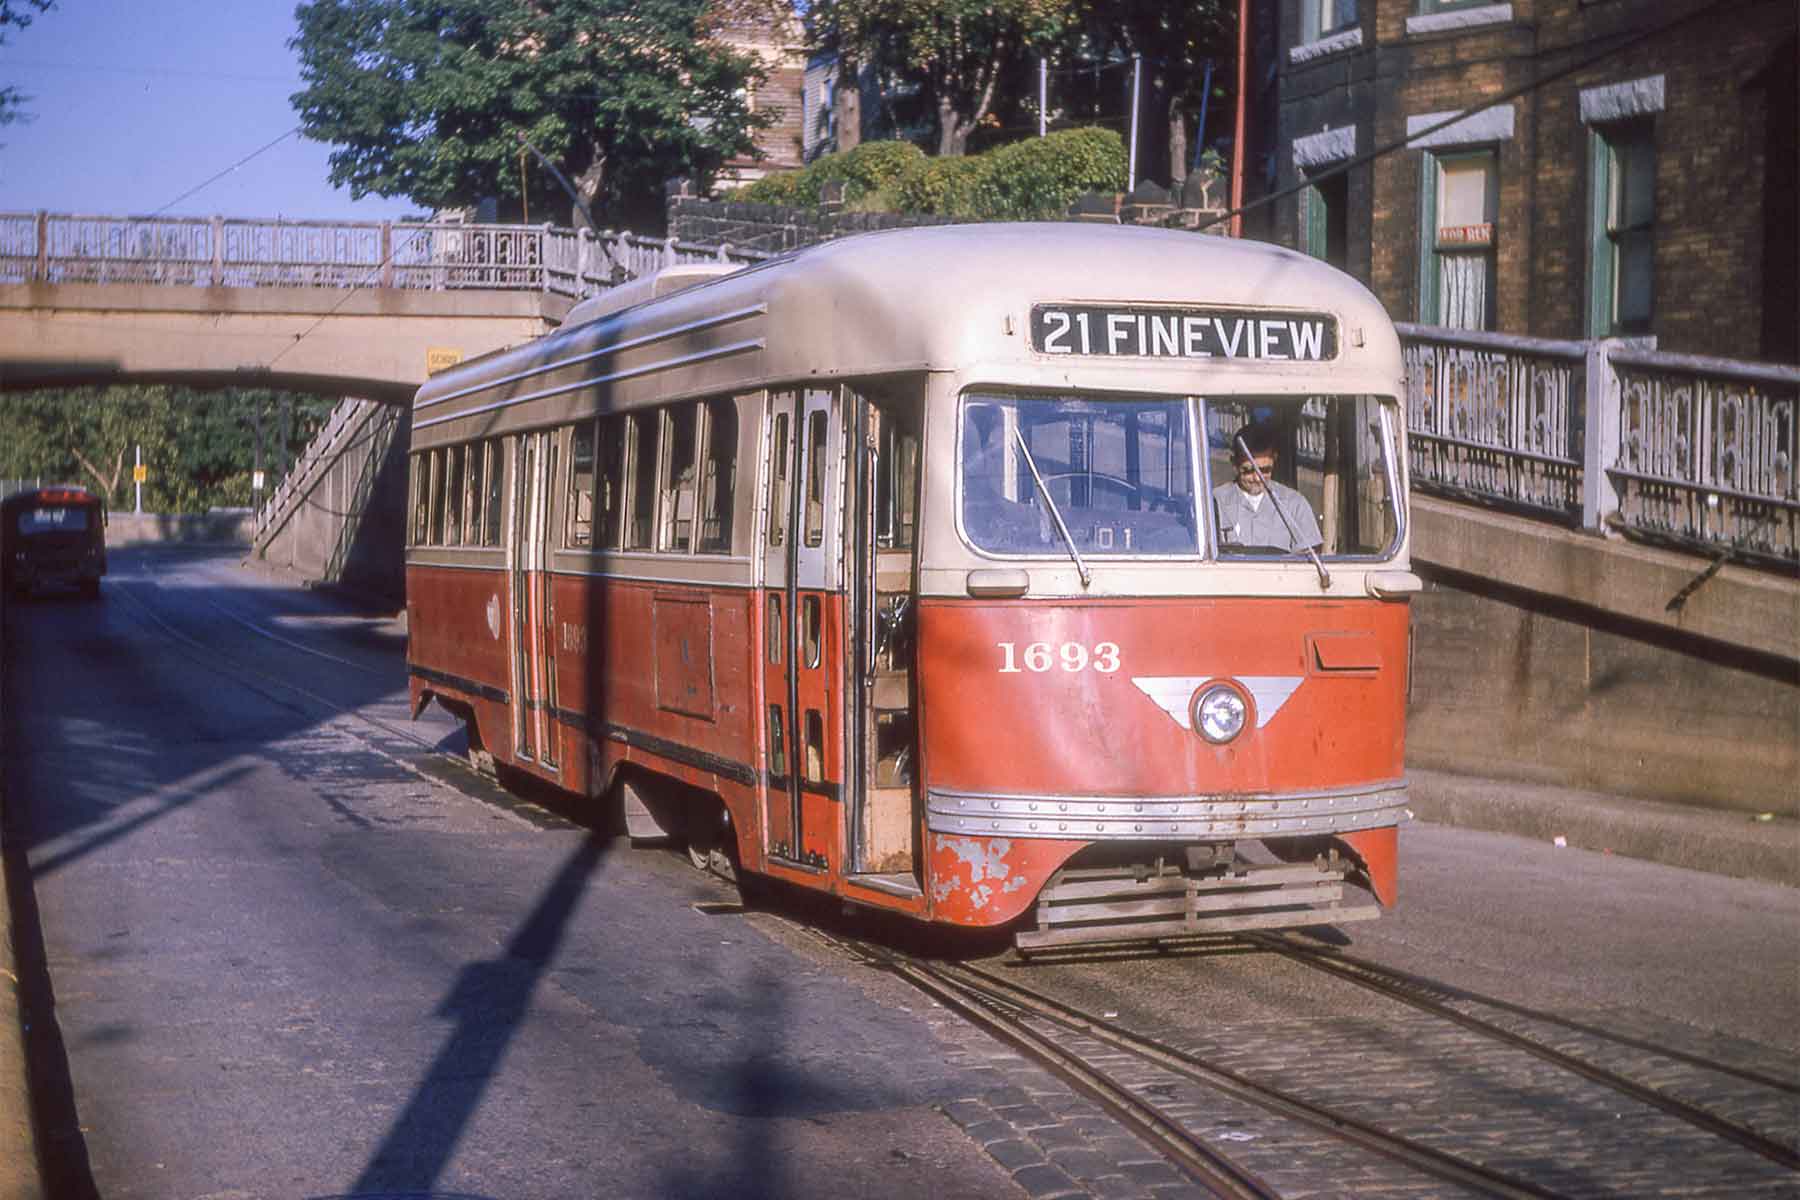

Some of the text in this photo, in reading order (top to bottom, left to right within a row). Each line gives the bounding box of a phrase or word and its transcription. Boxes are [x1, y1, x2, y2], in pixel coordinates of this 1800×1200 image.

[1043, 311, 1324, 361] 21 FINEVIEW
[997, 641, 1121, 673] 1693
